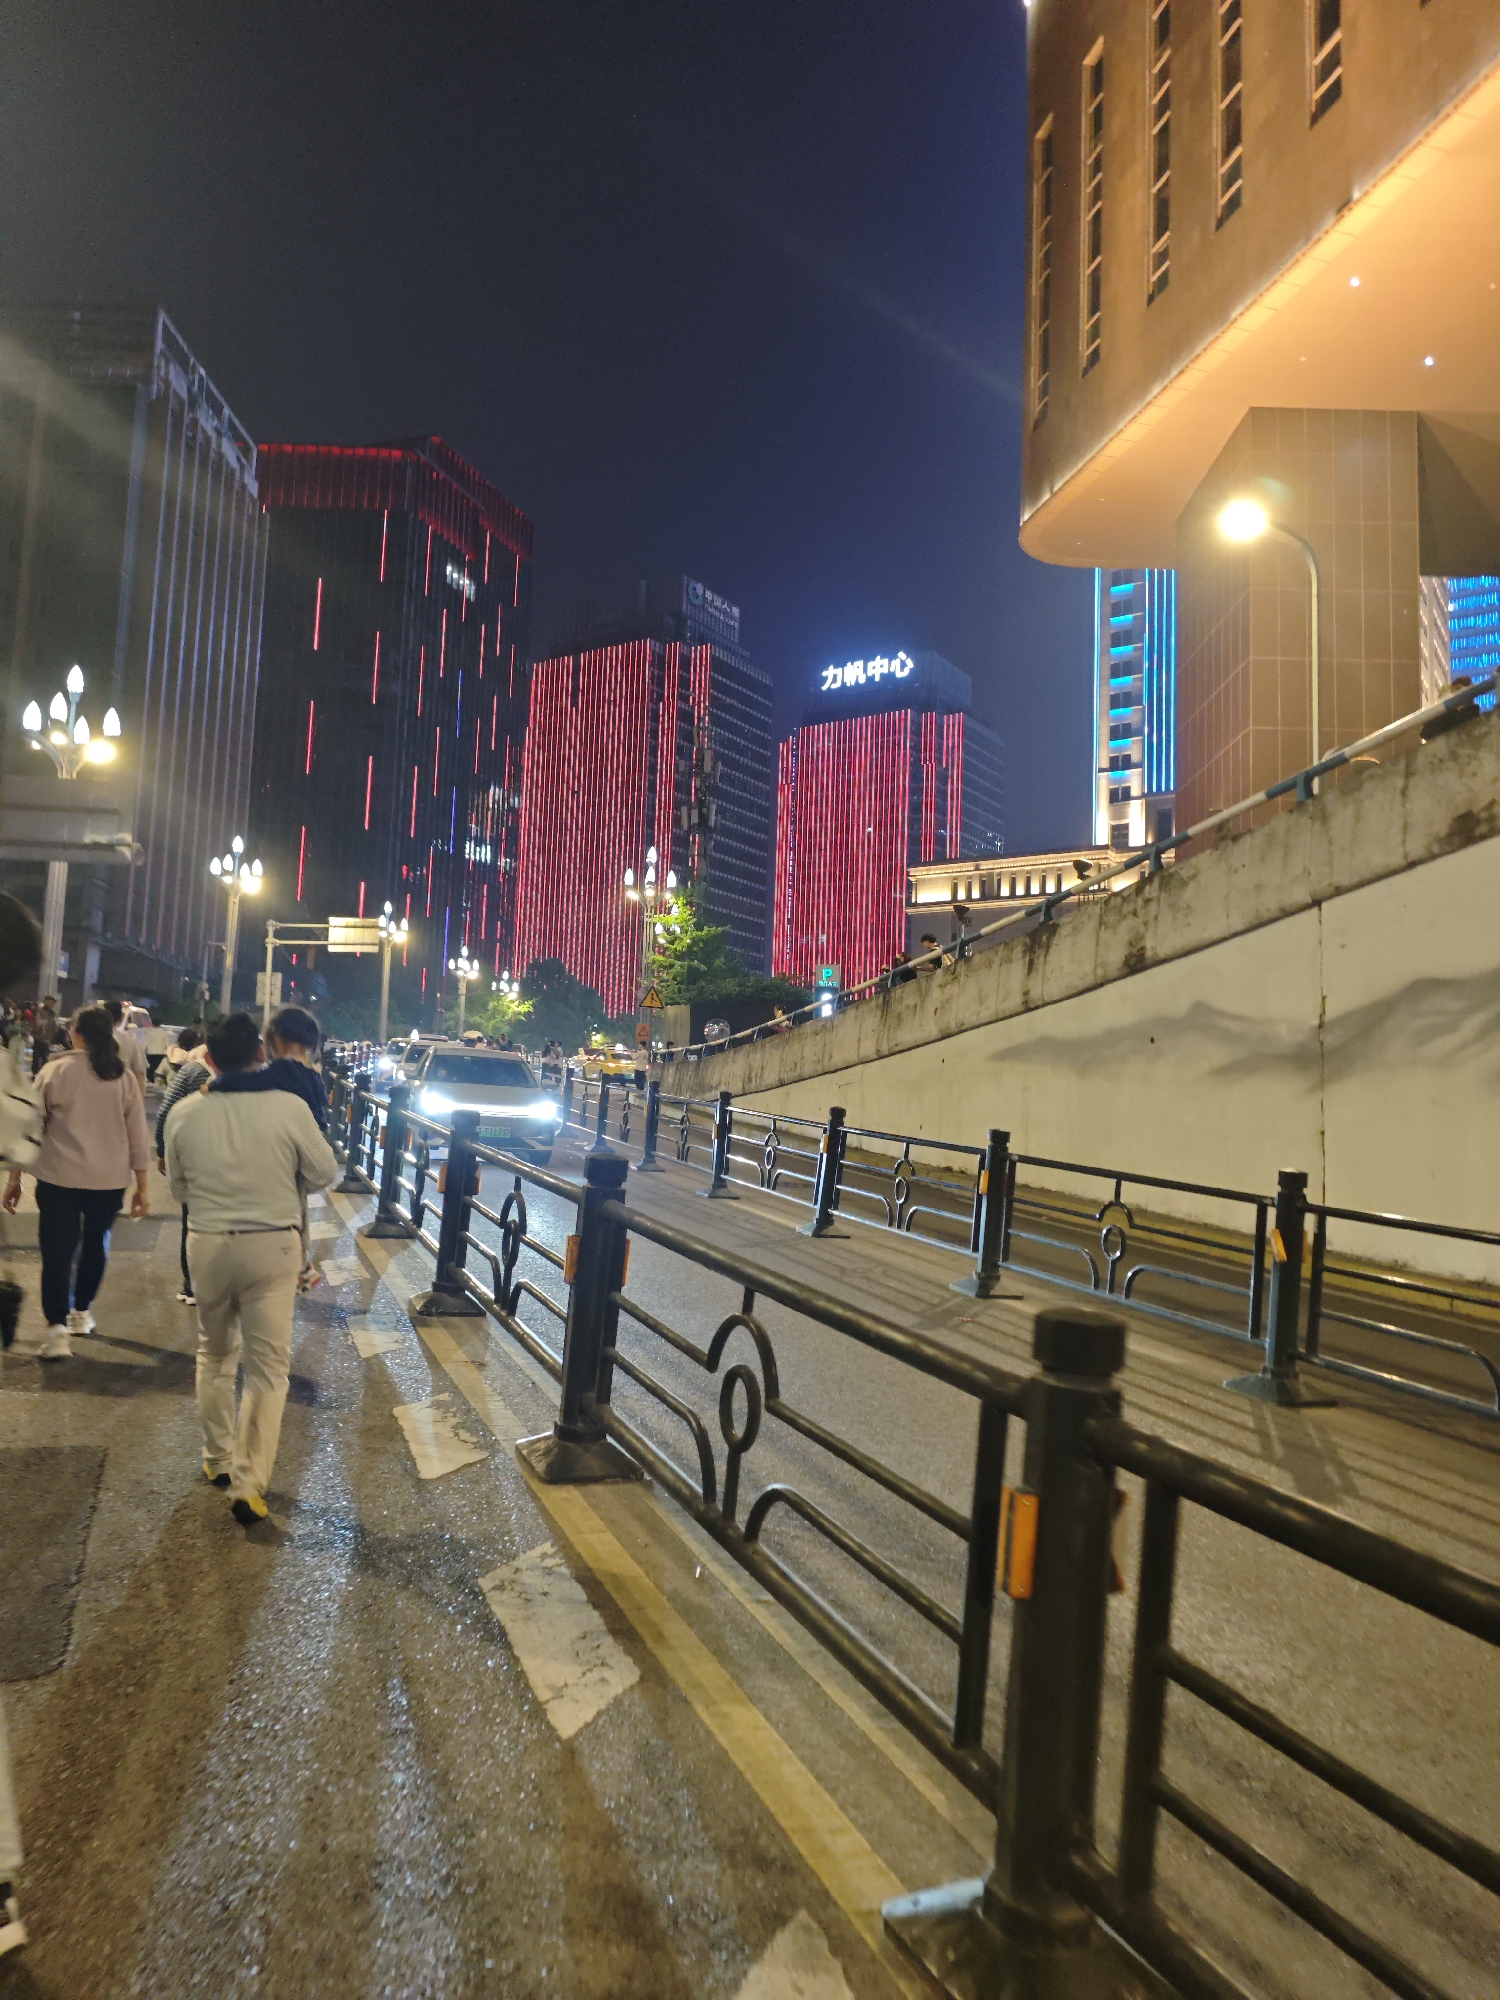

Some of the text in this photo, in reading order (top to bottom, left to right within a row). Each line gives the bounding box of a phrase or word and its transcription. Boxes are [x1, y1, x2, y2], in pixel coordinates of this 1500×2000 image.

[820, 650, 915, 691] 力帆中心
[822, 967, 834, 981] P
